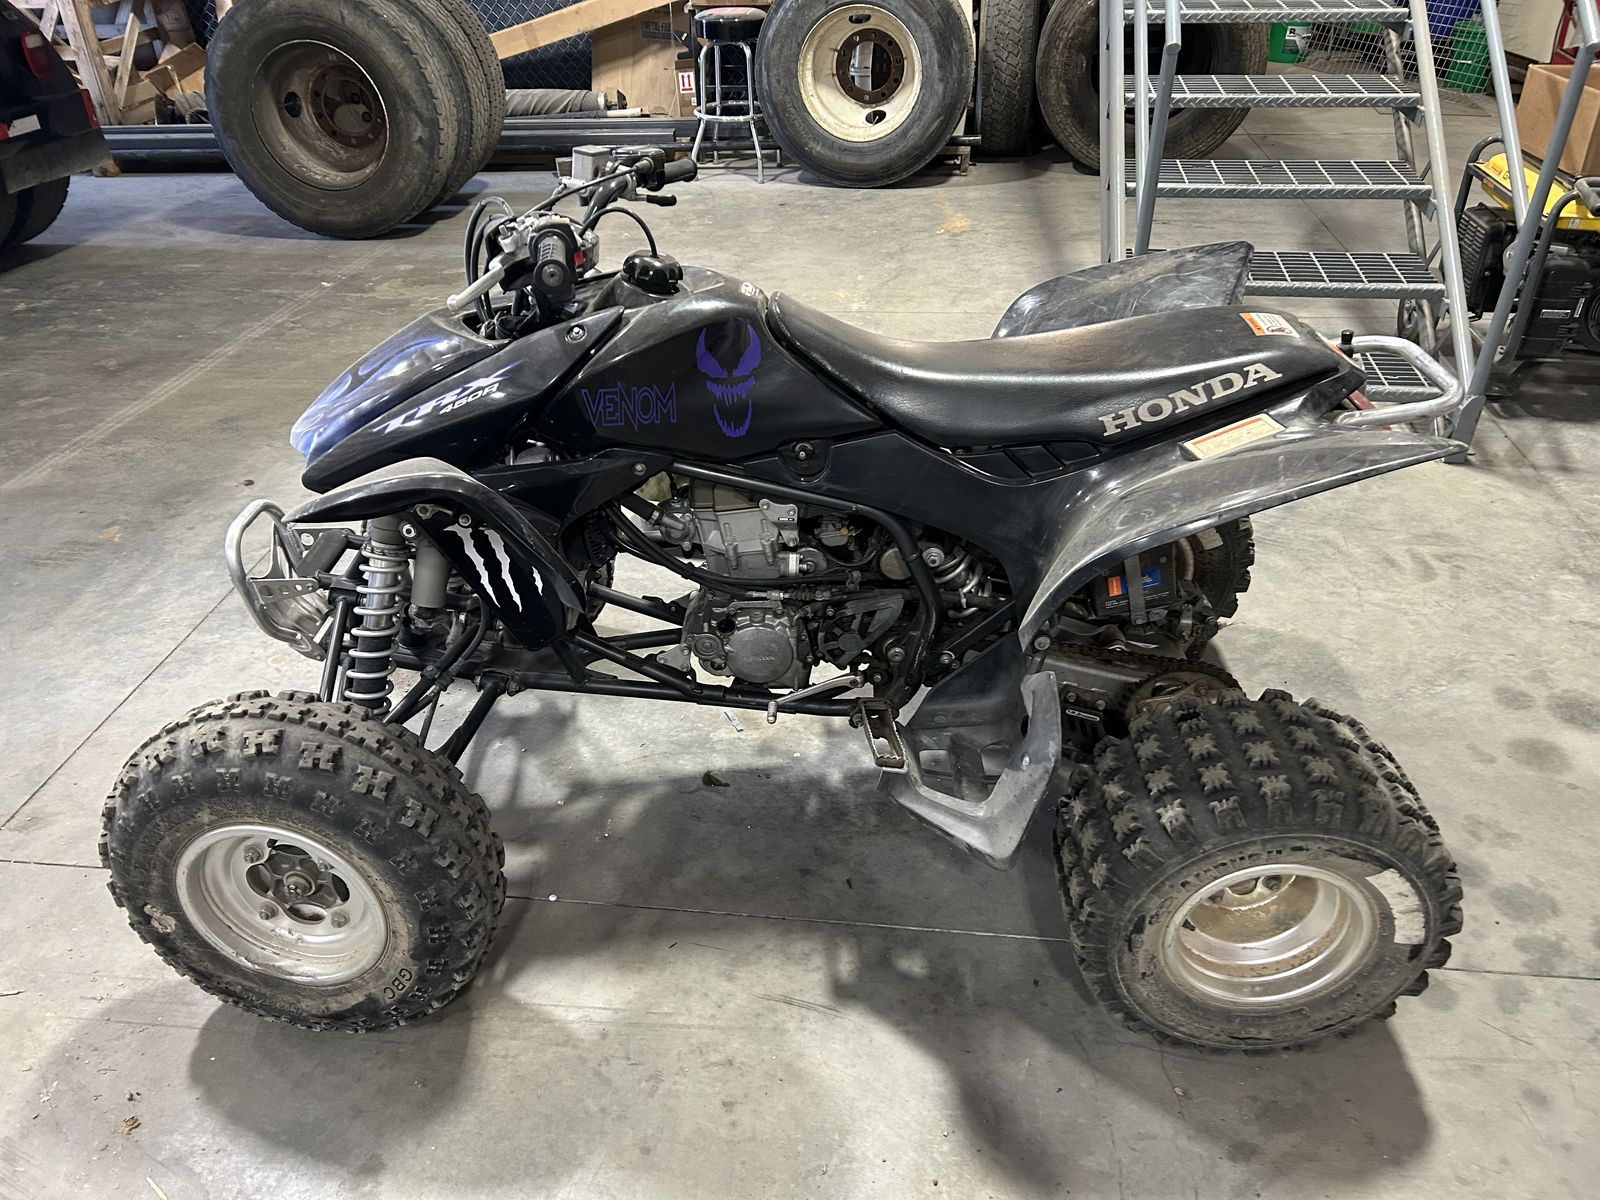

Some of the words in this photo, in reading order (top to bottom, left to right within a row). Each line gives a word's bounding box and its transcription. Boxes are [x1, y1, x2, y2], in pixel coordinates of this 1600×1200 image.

[439, 382, 500, 415] 450R
[580, 381, 677, 432] VENOM
[1098, 362, 1283, 437] HONDA
[383, 968, 413, 1000] GBC
